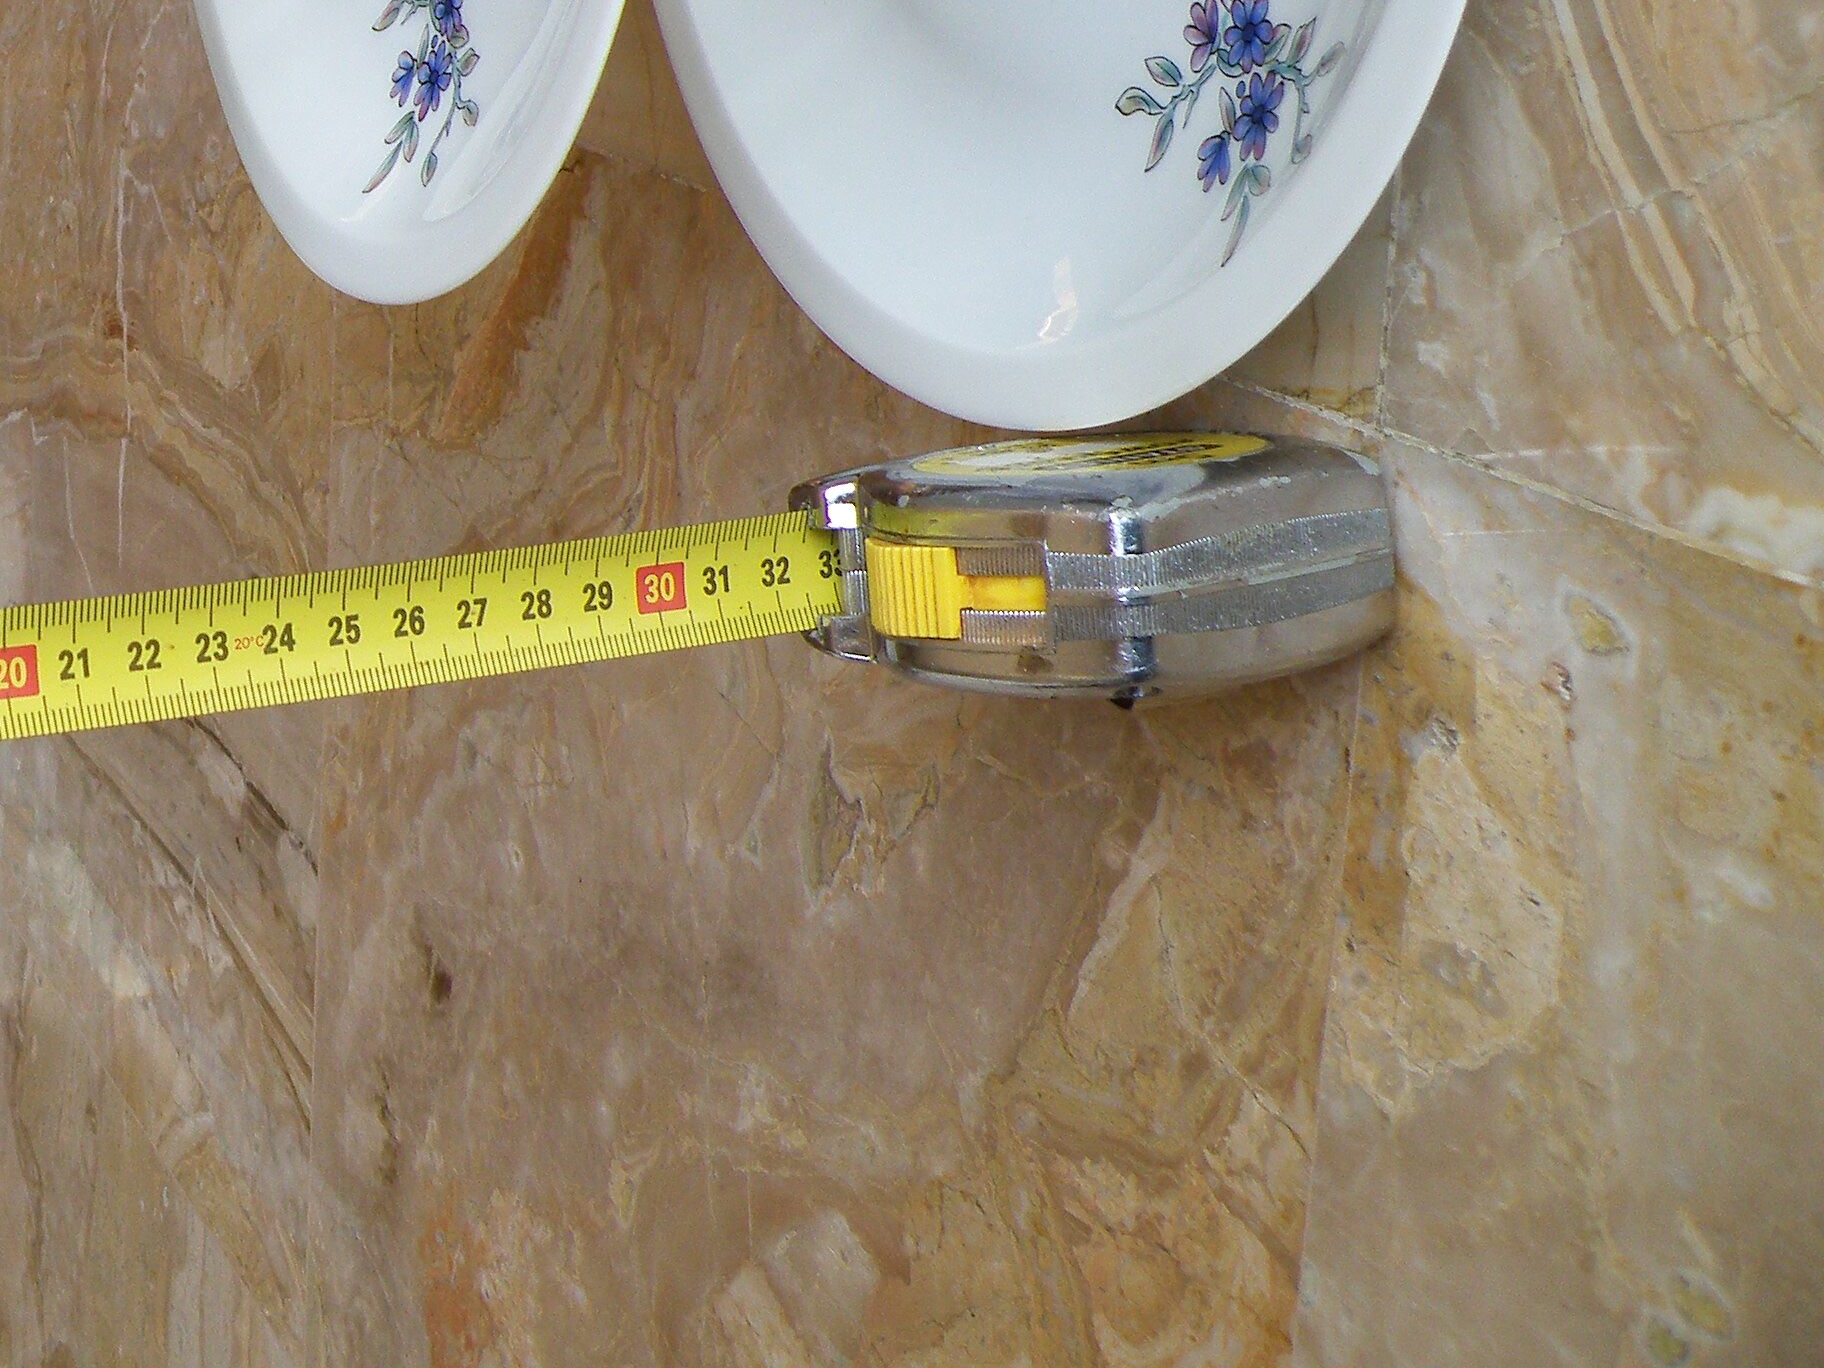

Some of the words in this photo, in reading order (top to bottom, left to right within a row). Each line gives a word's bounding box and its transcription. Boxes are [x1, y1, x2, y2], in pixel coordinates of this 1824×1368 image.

[59, 648, 91, 680] 21
[127, 639, 162, 673] 22
[195, 630, 229, 663] 23
[262, 622, 296, 655] 24
[328, 615, 361, 645] 25
[392, 607, 425, 637] 26
[456, 598, 488, 629] 27
[521, 590, 552, 620] 28
[582, 581, 613, 612] 29
[644, 572, 675, 604] 30
[702, 565, 730, 596] 31
[760, 556, 791, 587] 32
[234, 635, 264, 650] 20°C
